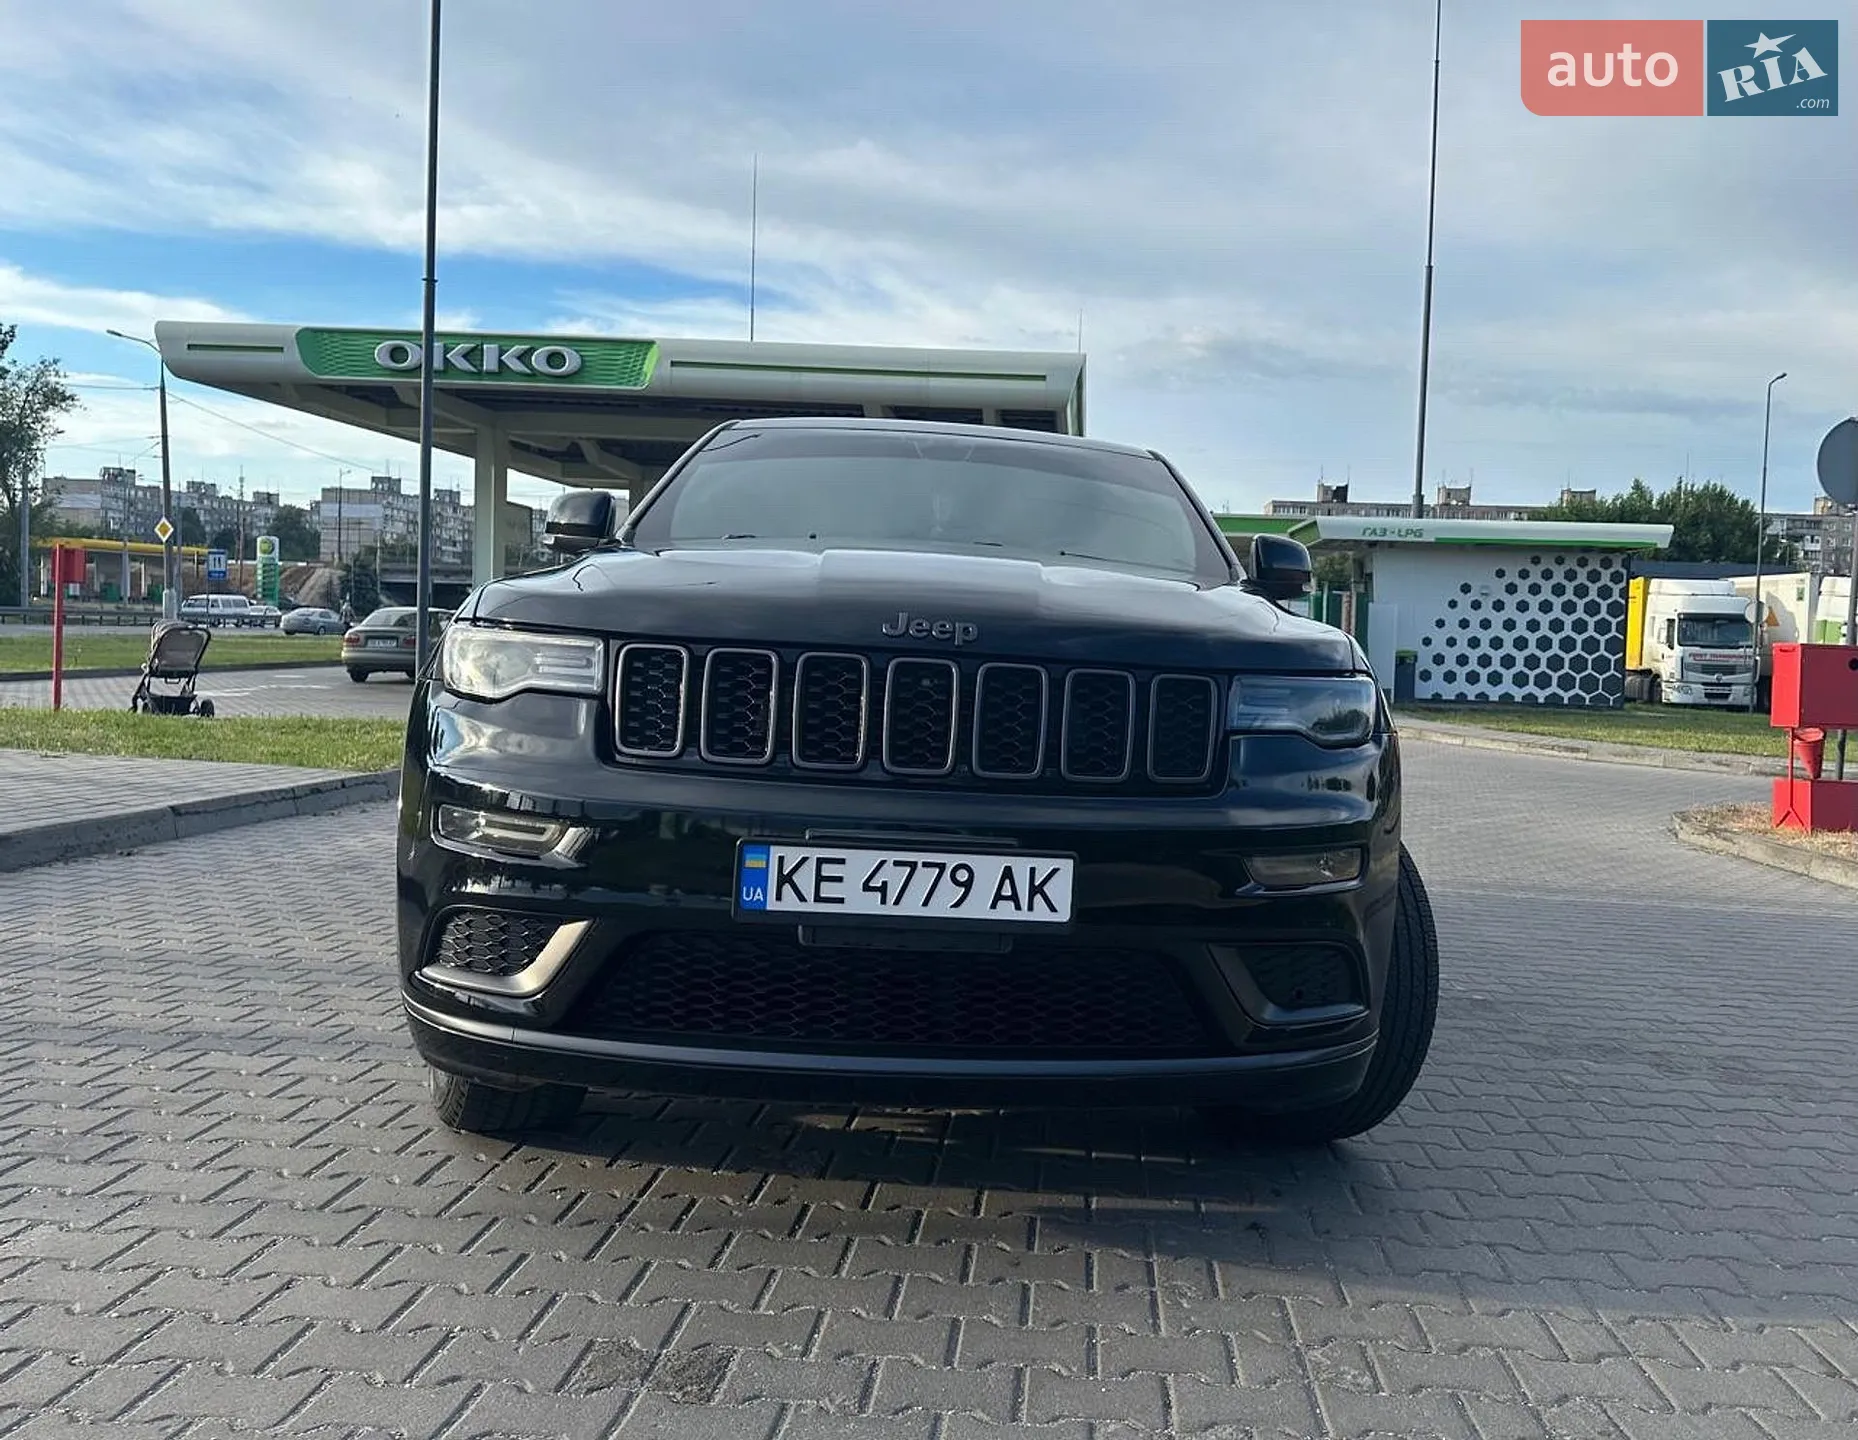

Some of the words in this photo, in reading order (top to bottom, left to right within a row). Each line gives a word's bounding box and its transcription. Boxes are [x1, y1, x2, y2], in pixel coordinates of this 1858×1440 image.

[374, 340, 582, 376] OKKO
[882, 611, 978, 646] Jeep
[742, 886, 764, 902] UA
[775, 855, 847, 904] KE
[861, 859, 975, 909] 4779
[990, 865, 1060, 913] AK
